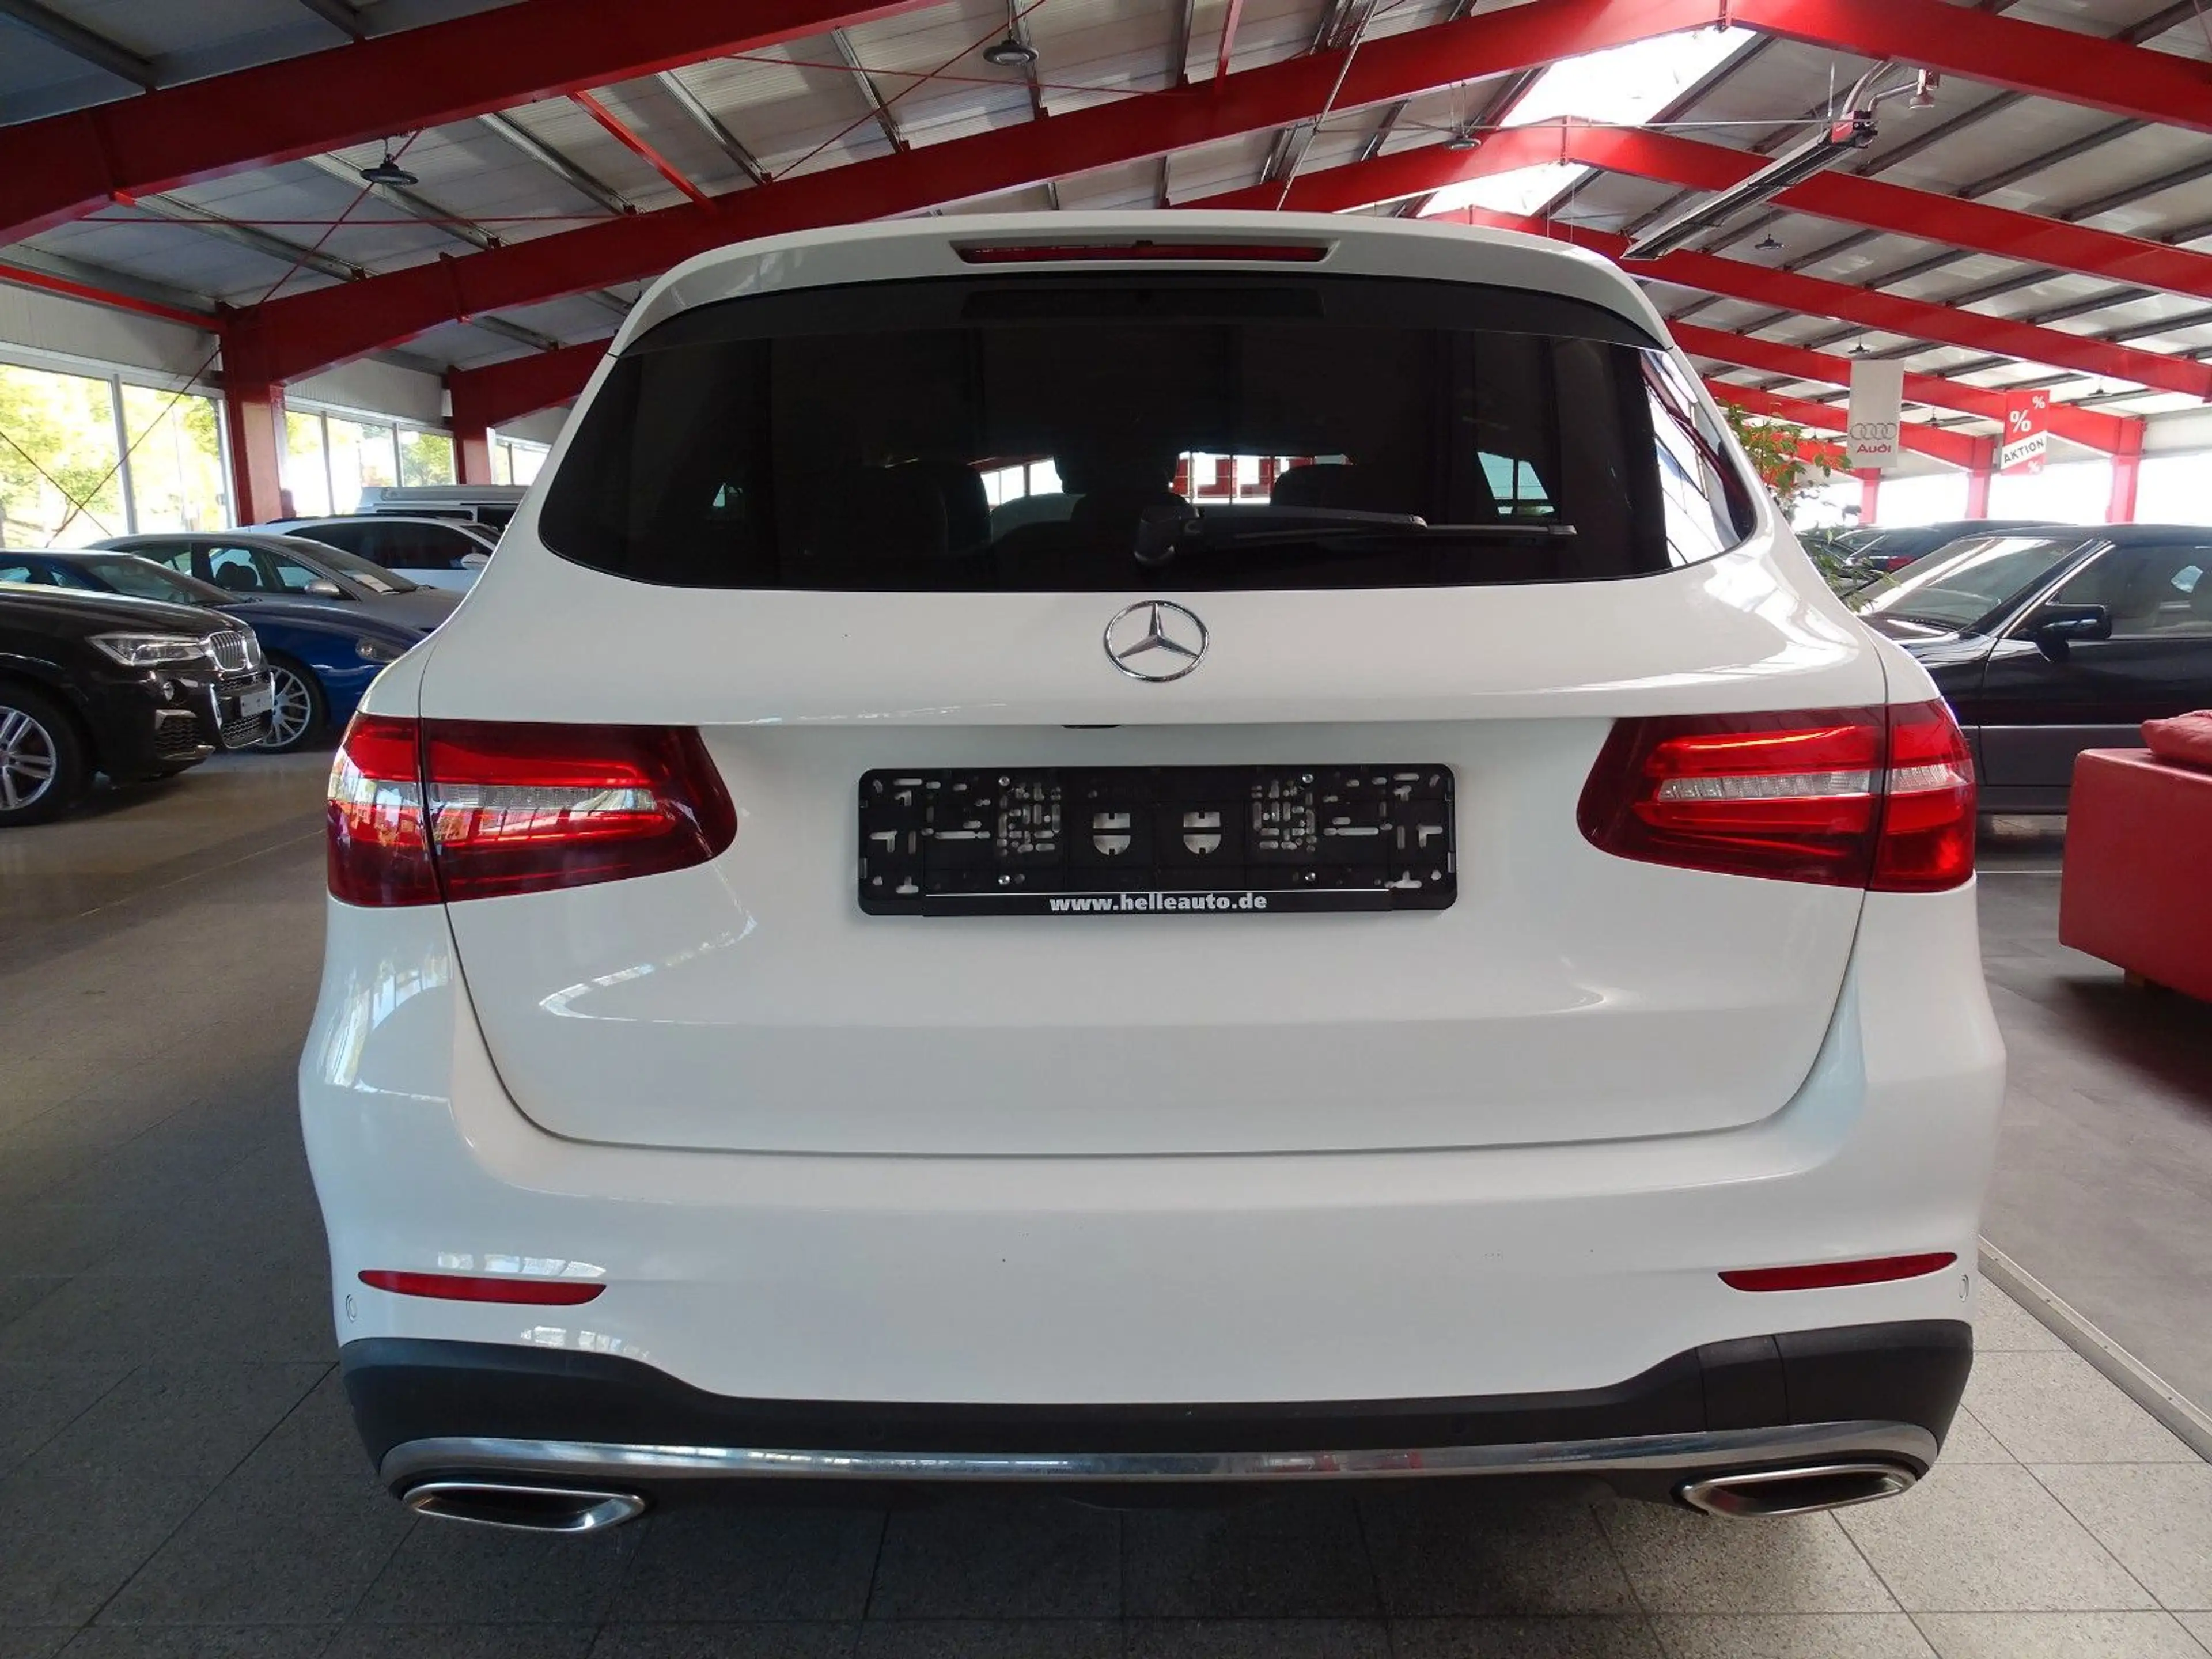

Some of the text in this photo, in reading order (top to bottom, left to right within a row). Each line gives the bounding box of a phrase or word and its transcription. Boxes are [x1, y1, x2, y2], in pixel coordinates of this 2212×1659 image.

[2032, 396, 2046, 409] %
[2010, 409, 2032, 432] %
[1857, 444, 1891, 453] Audi
[2004, 438, 2044, 463] AKTION
[1050, 893, 1267, 911] www.helleauto.de
